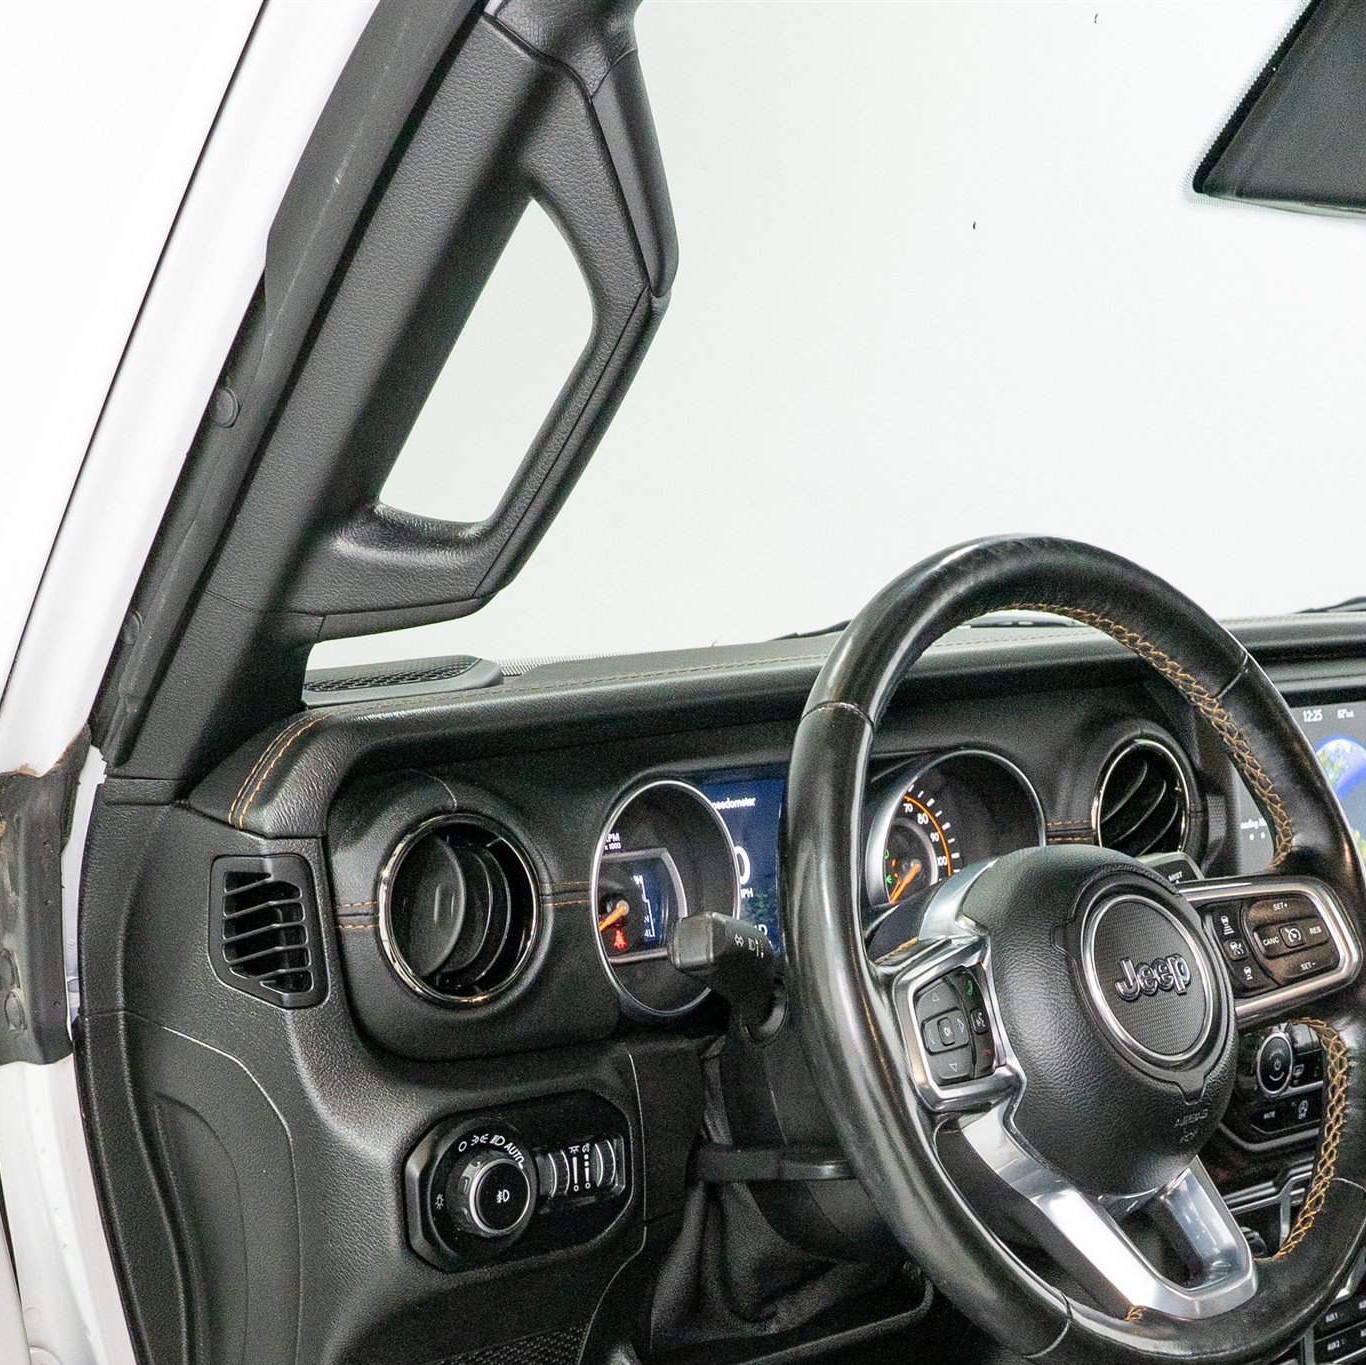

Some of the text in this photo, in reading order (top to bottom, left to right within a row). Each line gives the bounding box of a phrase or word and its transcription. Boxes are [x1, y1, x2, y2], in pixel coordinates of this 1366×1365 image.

[903, 803, 914, 813] 70
[917, 812, 929, 825] 80
[930, 832, 940, 843] 90
[937, 856, 948, 866] 100
[1309, 926, 1322, 935] RES
[1262, 937, 1280, 947] CANC
[1114, 954, 1191, 1002] Jeep
[503, 1142, 525, 1165] AUTO
